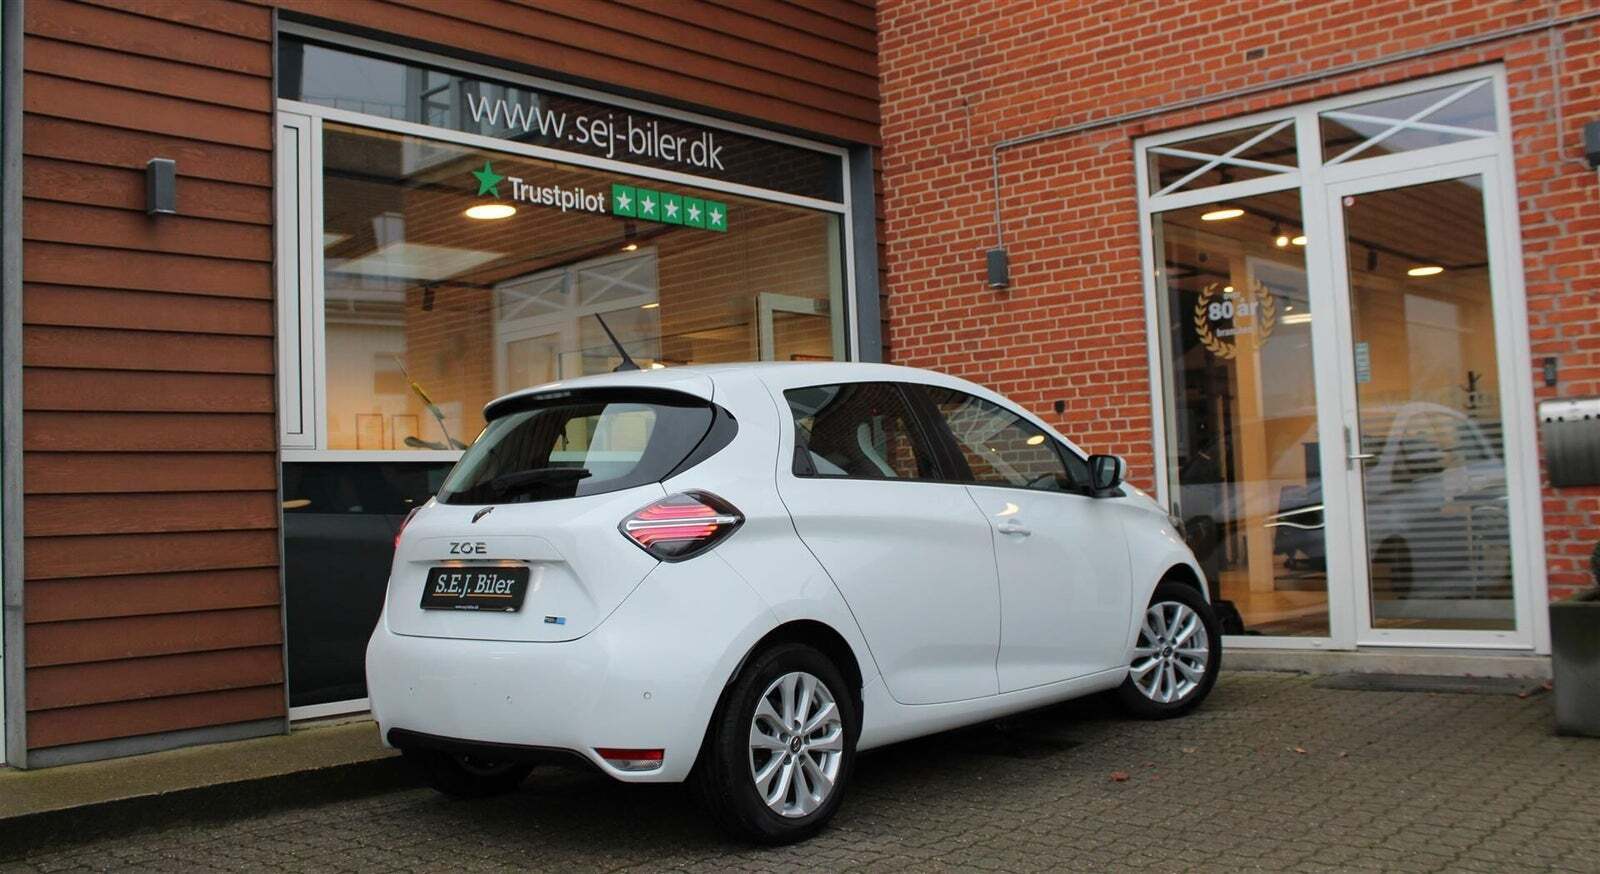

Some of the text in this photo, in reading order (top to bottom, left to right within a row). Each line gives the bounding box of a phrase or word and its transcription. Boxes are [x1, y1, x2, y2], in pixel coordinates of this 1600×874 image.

[467, 93, 724, 170] www.sej-biler.dk
[508, 176, 606, 213] Trustpilot
[1208, 301, 1233, 320] 80
[450, 542, 487, 554] ZOE
[435, 574, 515, 598] S.E.J. Biler
